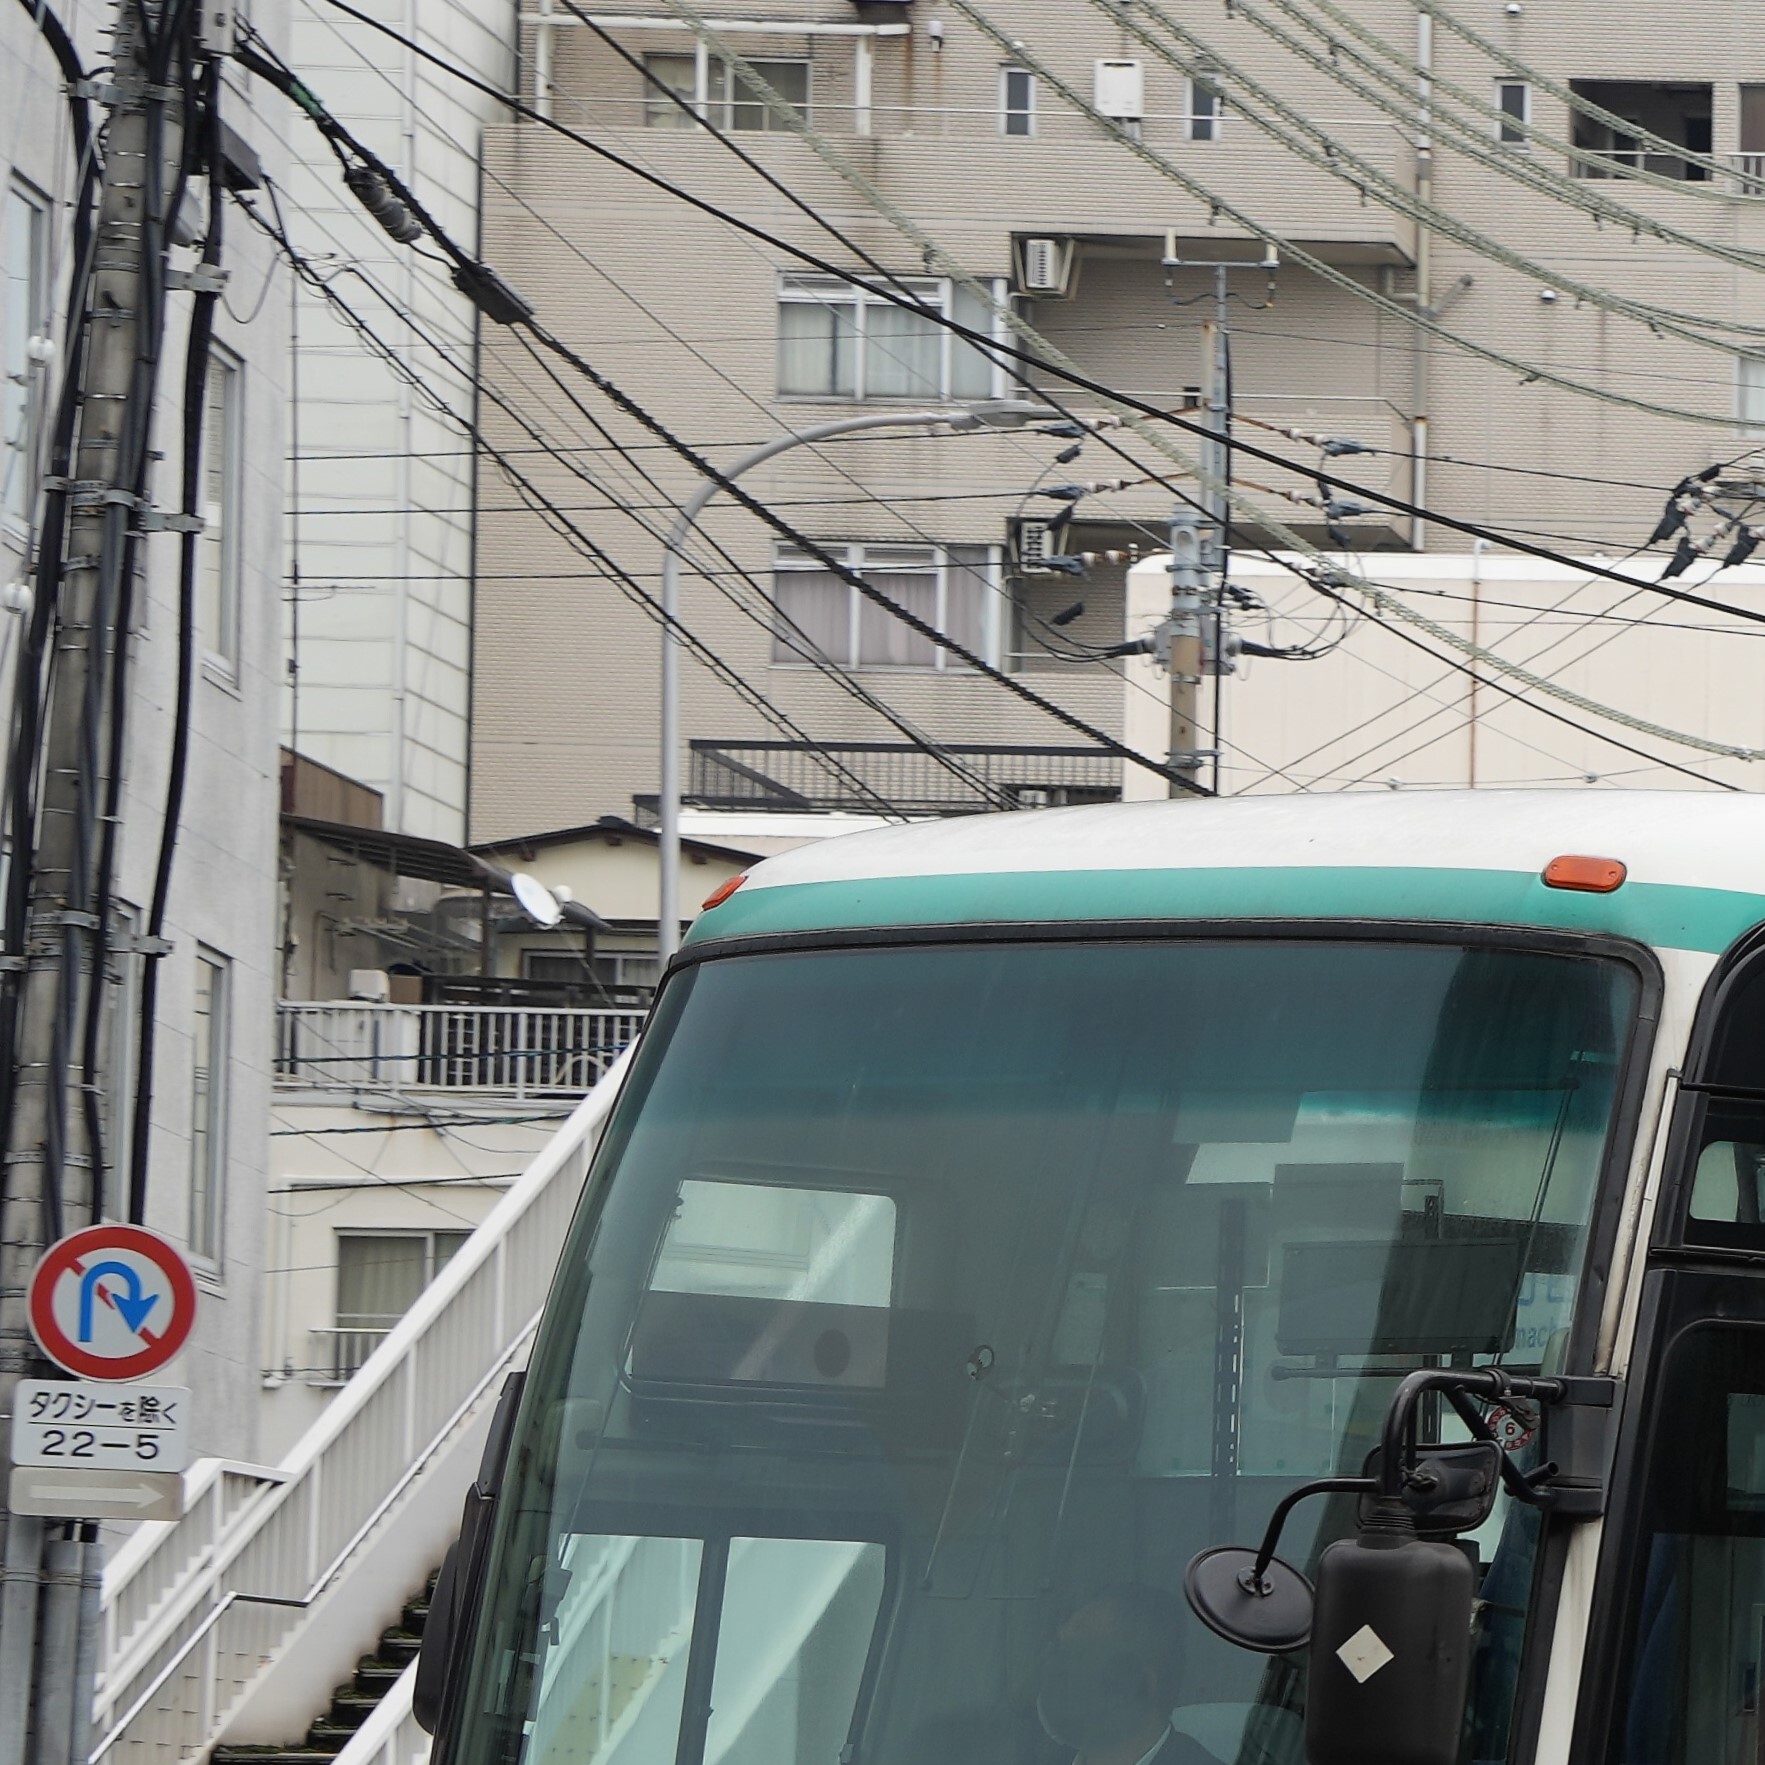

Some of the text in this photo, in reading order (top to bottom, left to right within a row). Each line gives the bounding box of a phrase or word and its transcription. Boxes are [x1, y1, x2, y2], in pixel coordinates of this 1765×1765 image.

[30, 1391, 177, 1424] タクシーを除く
[1505, 1422, 1516, 1435] 6
[41, 1430, 159, 1460] 22-5
